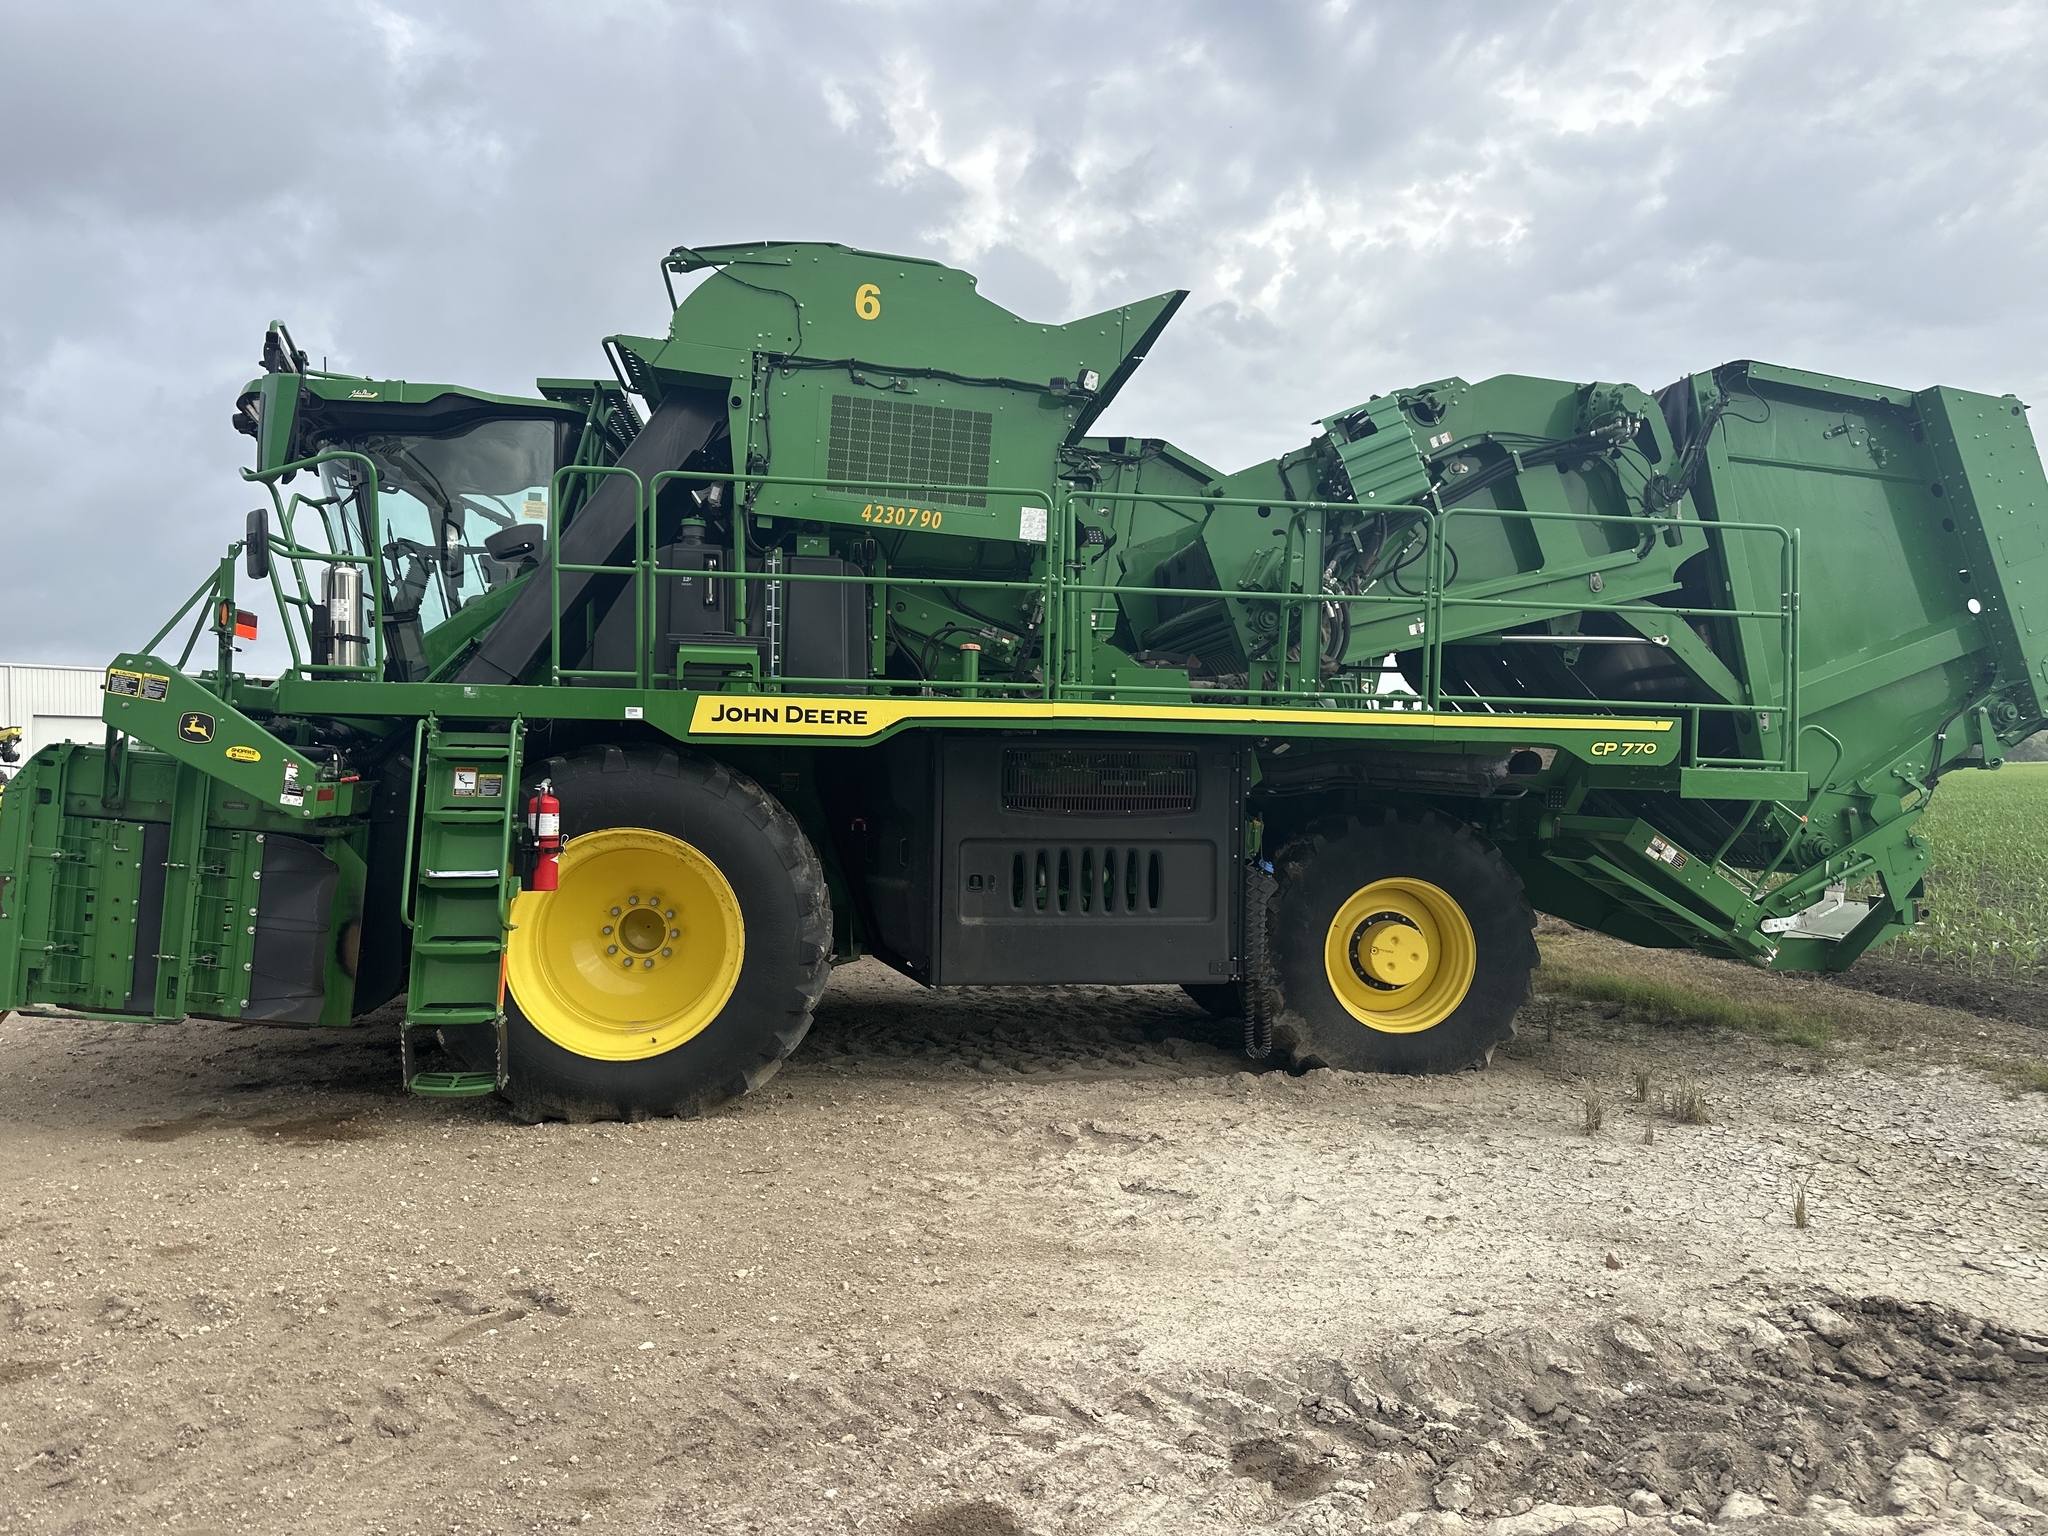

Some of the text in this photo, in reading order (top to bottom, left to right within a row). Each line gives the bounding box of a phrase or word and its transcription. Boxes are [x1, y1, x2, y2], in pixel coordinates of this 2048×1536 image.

[855, 283, 881, 320] 6
[861, 503, 943, 530] 4230790
[711, 704, 868, 725] JOHN DEERE
[1590, 742, 1658, 757] CP 770
